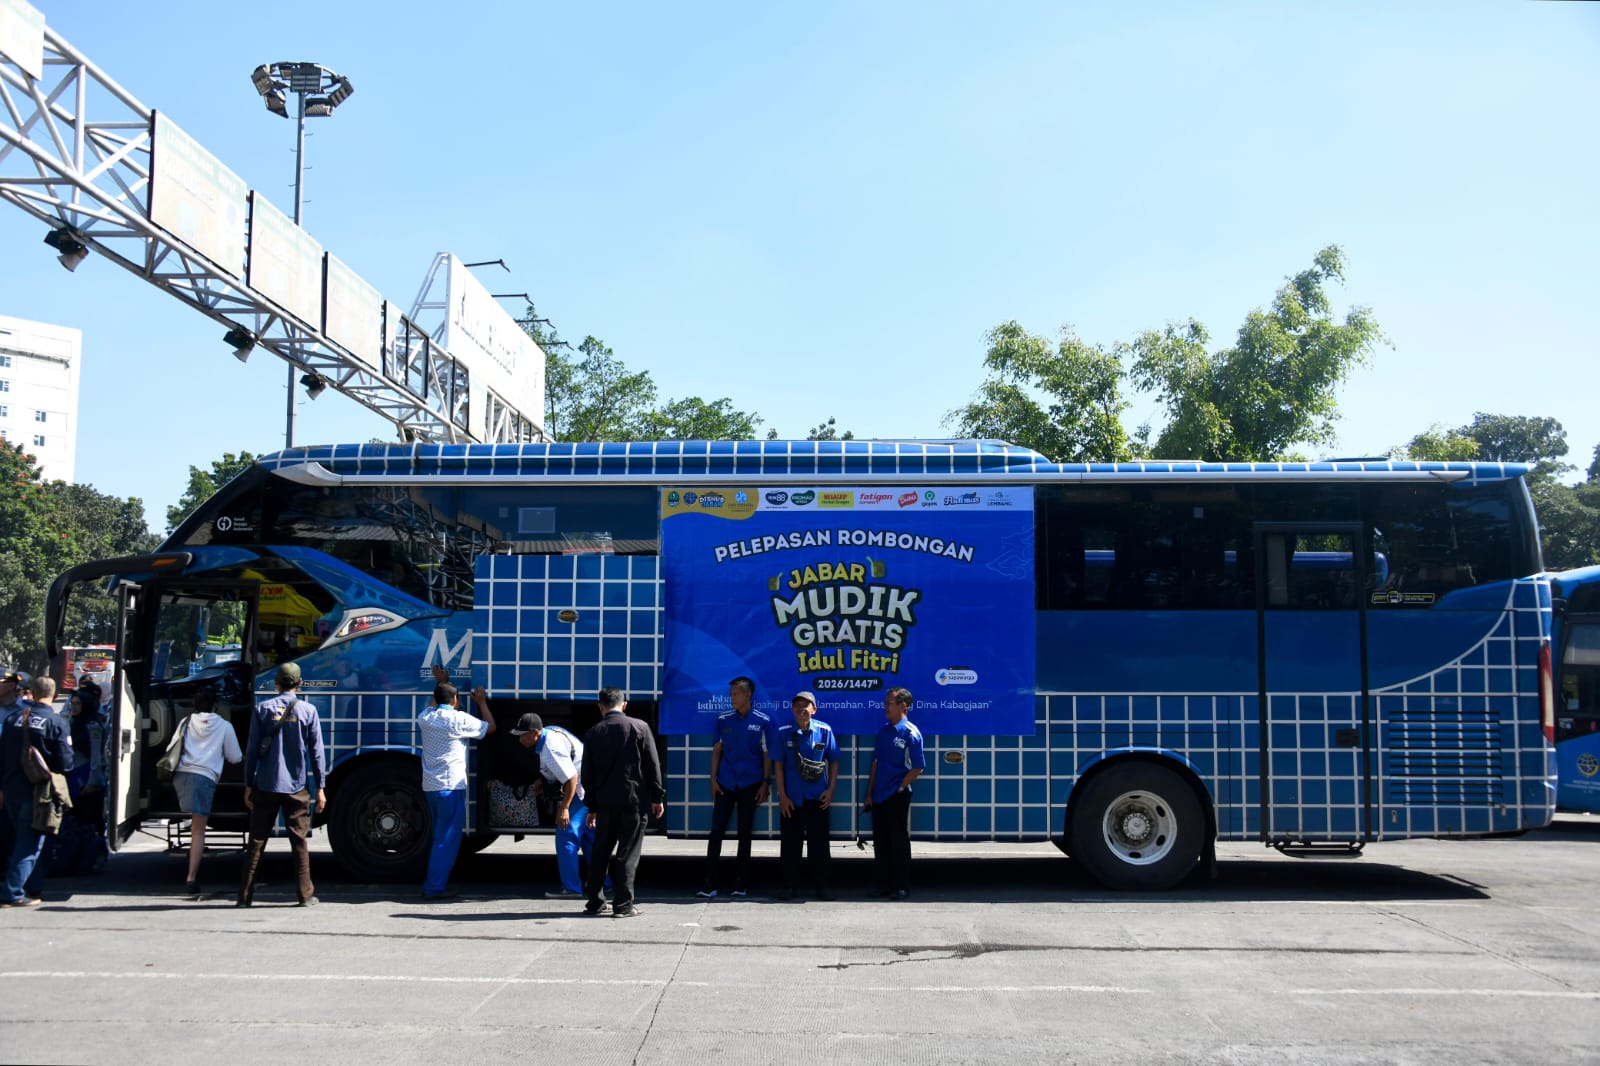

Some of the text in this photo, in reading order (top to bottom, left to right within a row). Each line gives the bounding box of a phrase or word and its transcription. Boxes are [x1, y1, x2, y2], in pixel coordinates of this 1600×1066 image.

[714, 529, 974, 562] PELEPASAN ROMBONGAN
[788, 562, 865, 589] JABAR
[773, 585, 918, 624] MUDIK
[793, 618, 903, 649] GRATIS
[797, 648, 899, 673] Idul Fitri
[697, 699, 734, 710] Istimew
[916, 700, 938, 709] Dina
